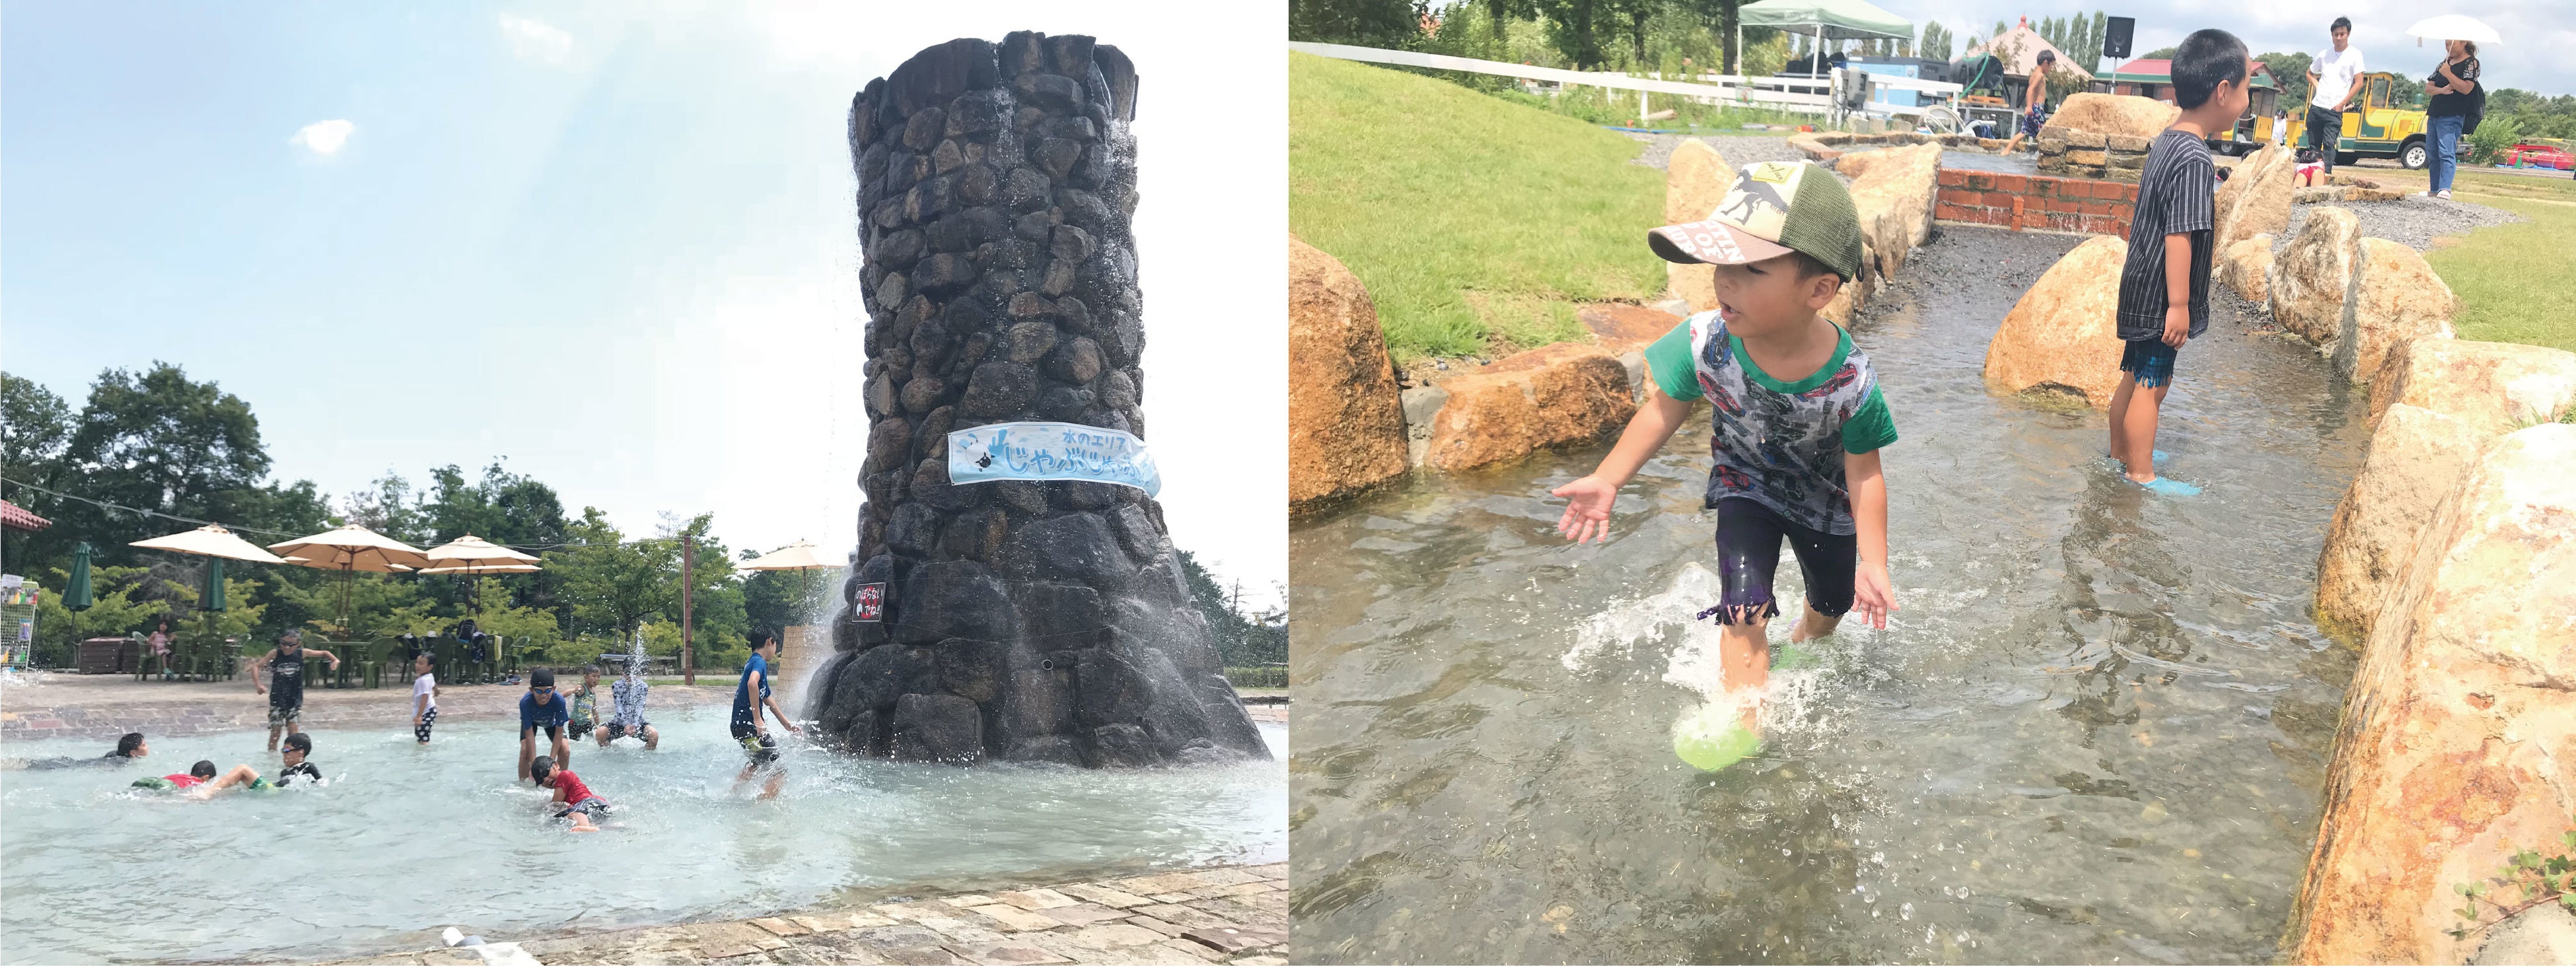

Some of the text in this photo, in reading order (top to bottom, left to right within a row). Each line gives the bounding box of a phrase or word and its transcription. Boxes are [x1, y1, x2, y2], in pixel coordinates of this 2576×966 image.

[1063, 431, 1126, 450] 水のエリア
